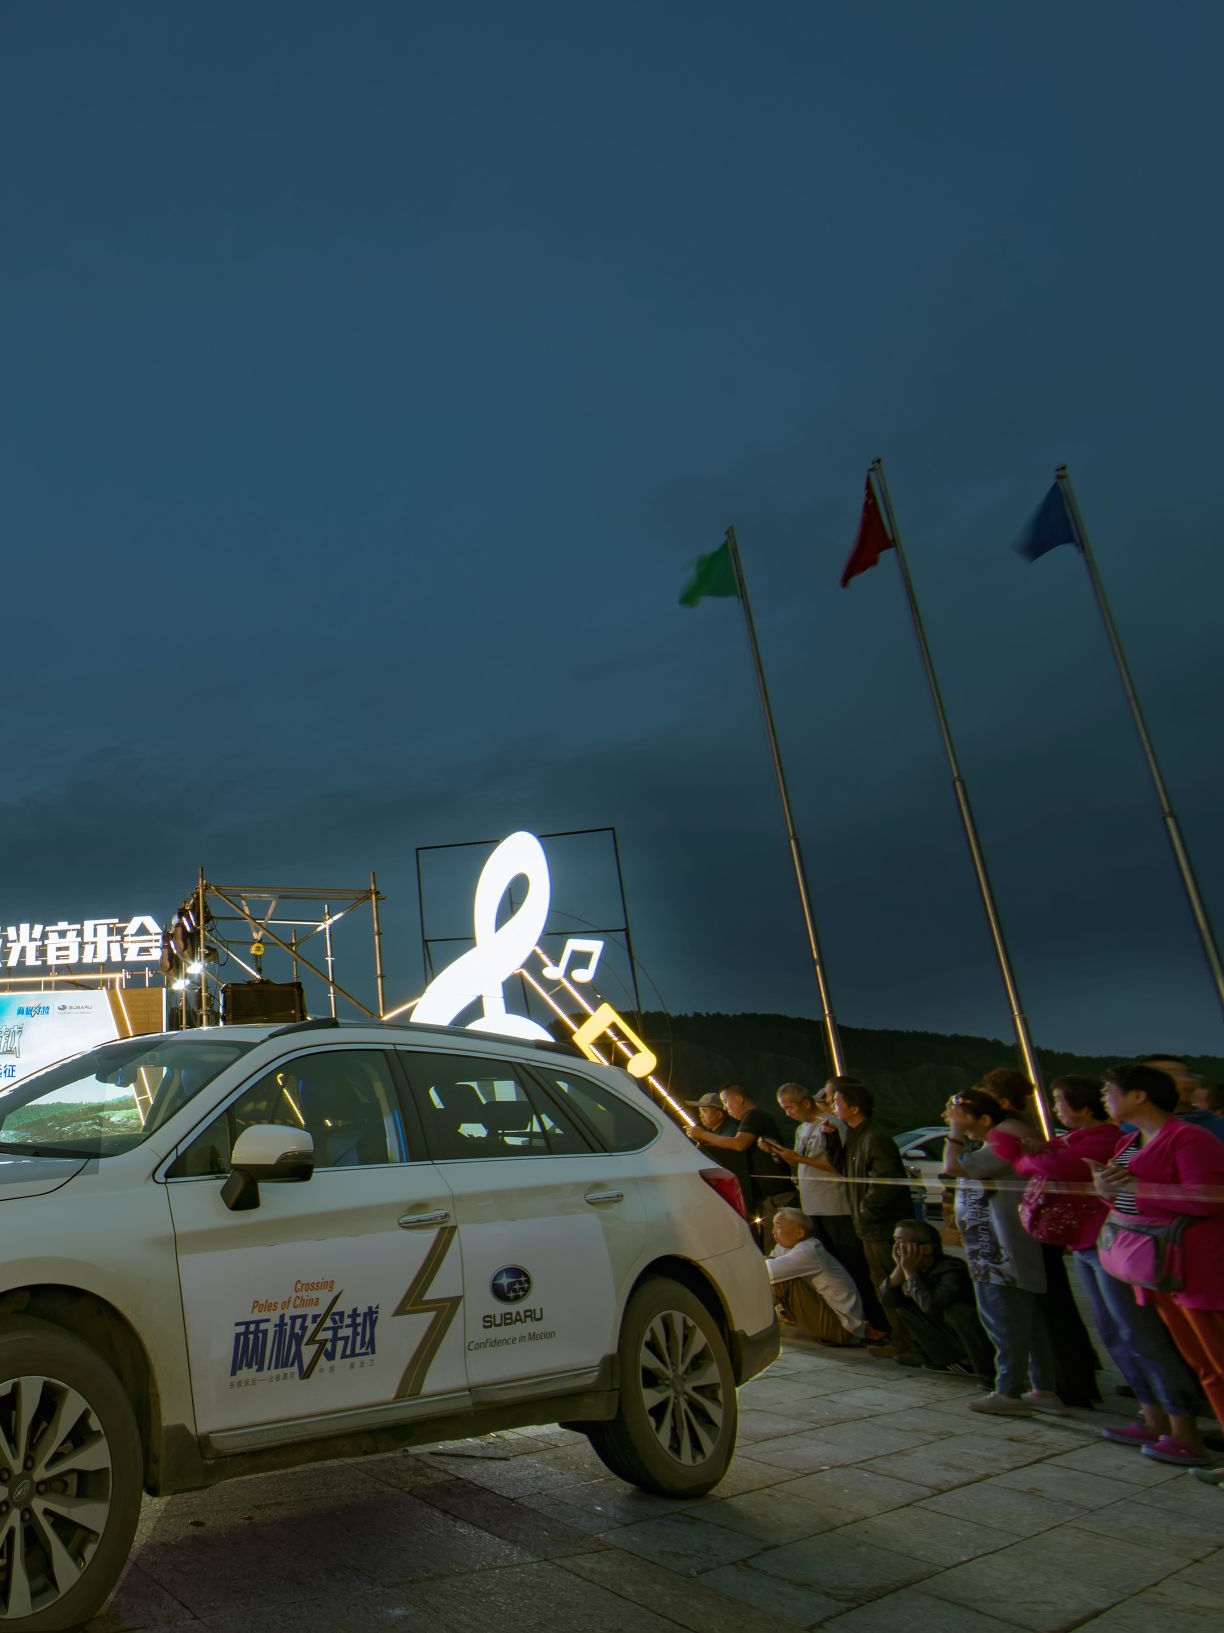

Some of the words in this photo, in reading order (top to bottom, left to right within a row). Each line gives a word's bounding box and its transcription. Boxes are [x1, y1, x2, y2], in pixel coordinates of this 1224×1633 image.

[294, 1278, 335, 1294] Crossing
[251, 1299, 279, 1314] Poles
[281, 1297, 291, 1310] of
[293, 1295, 320, 1309] China
[482, 1307, 543, 1329] SUBARU
[230, 1303, 380, 1380] 两极穿越
[467, 1334, 517, 1352] Confidence
[518, 1334, 526, 1344] in
[527, 1330, 556, 1342] Motion
